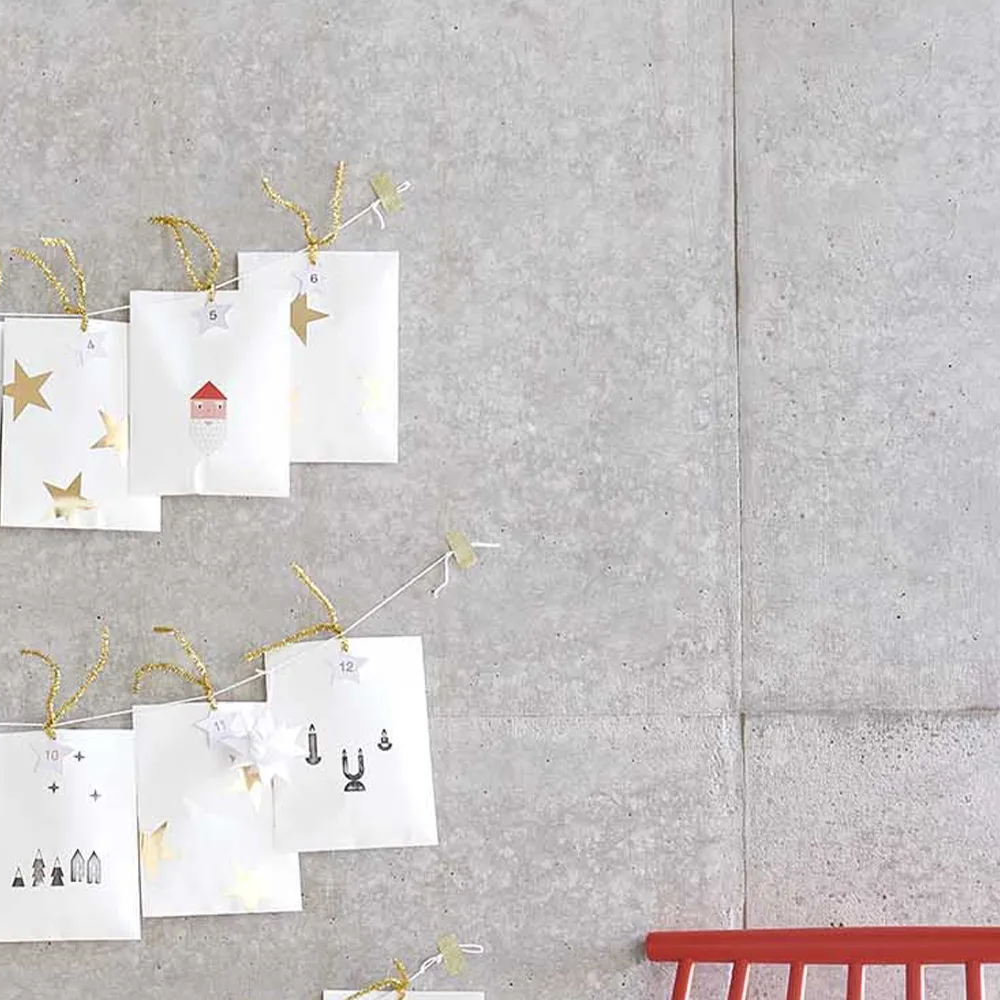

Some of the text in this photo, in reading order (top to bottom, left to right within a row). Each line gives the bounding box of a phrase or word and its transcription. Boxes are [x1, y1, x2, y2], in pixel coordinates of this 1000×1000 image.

[309, 273, 319, 284] 6
[208, 309, 218, 321] 5
[86, 339, 96, 351] 4
[338, 661, 355, 673] 12
[44, 749, 60, 762] 10
